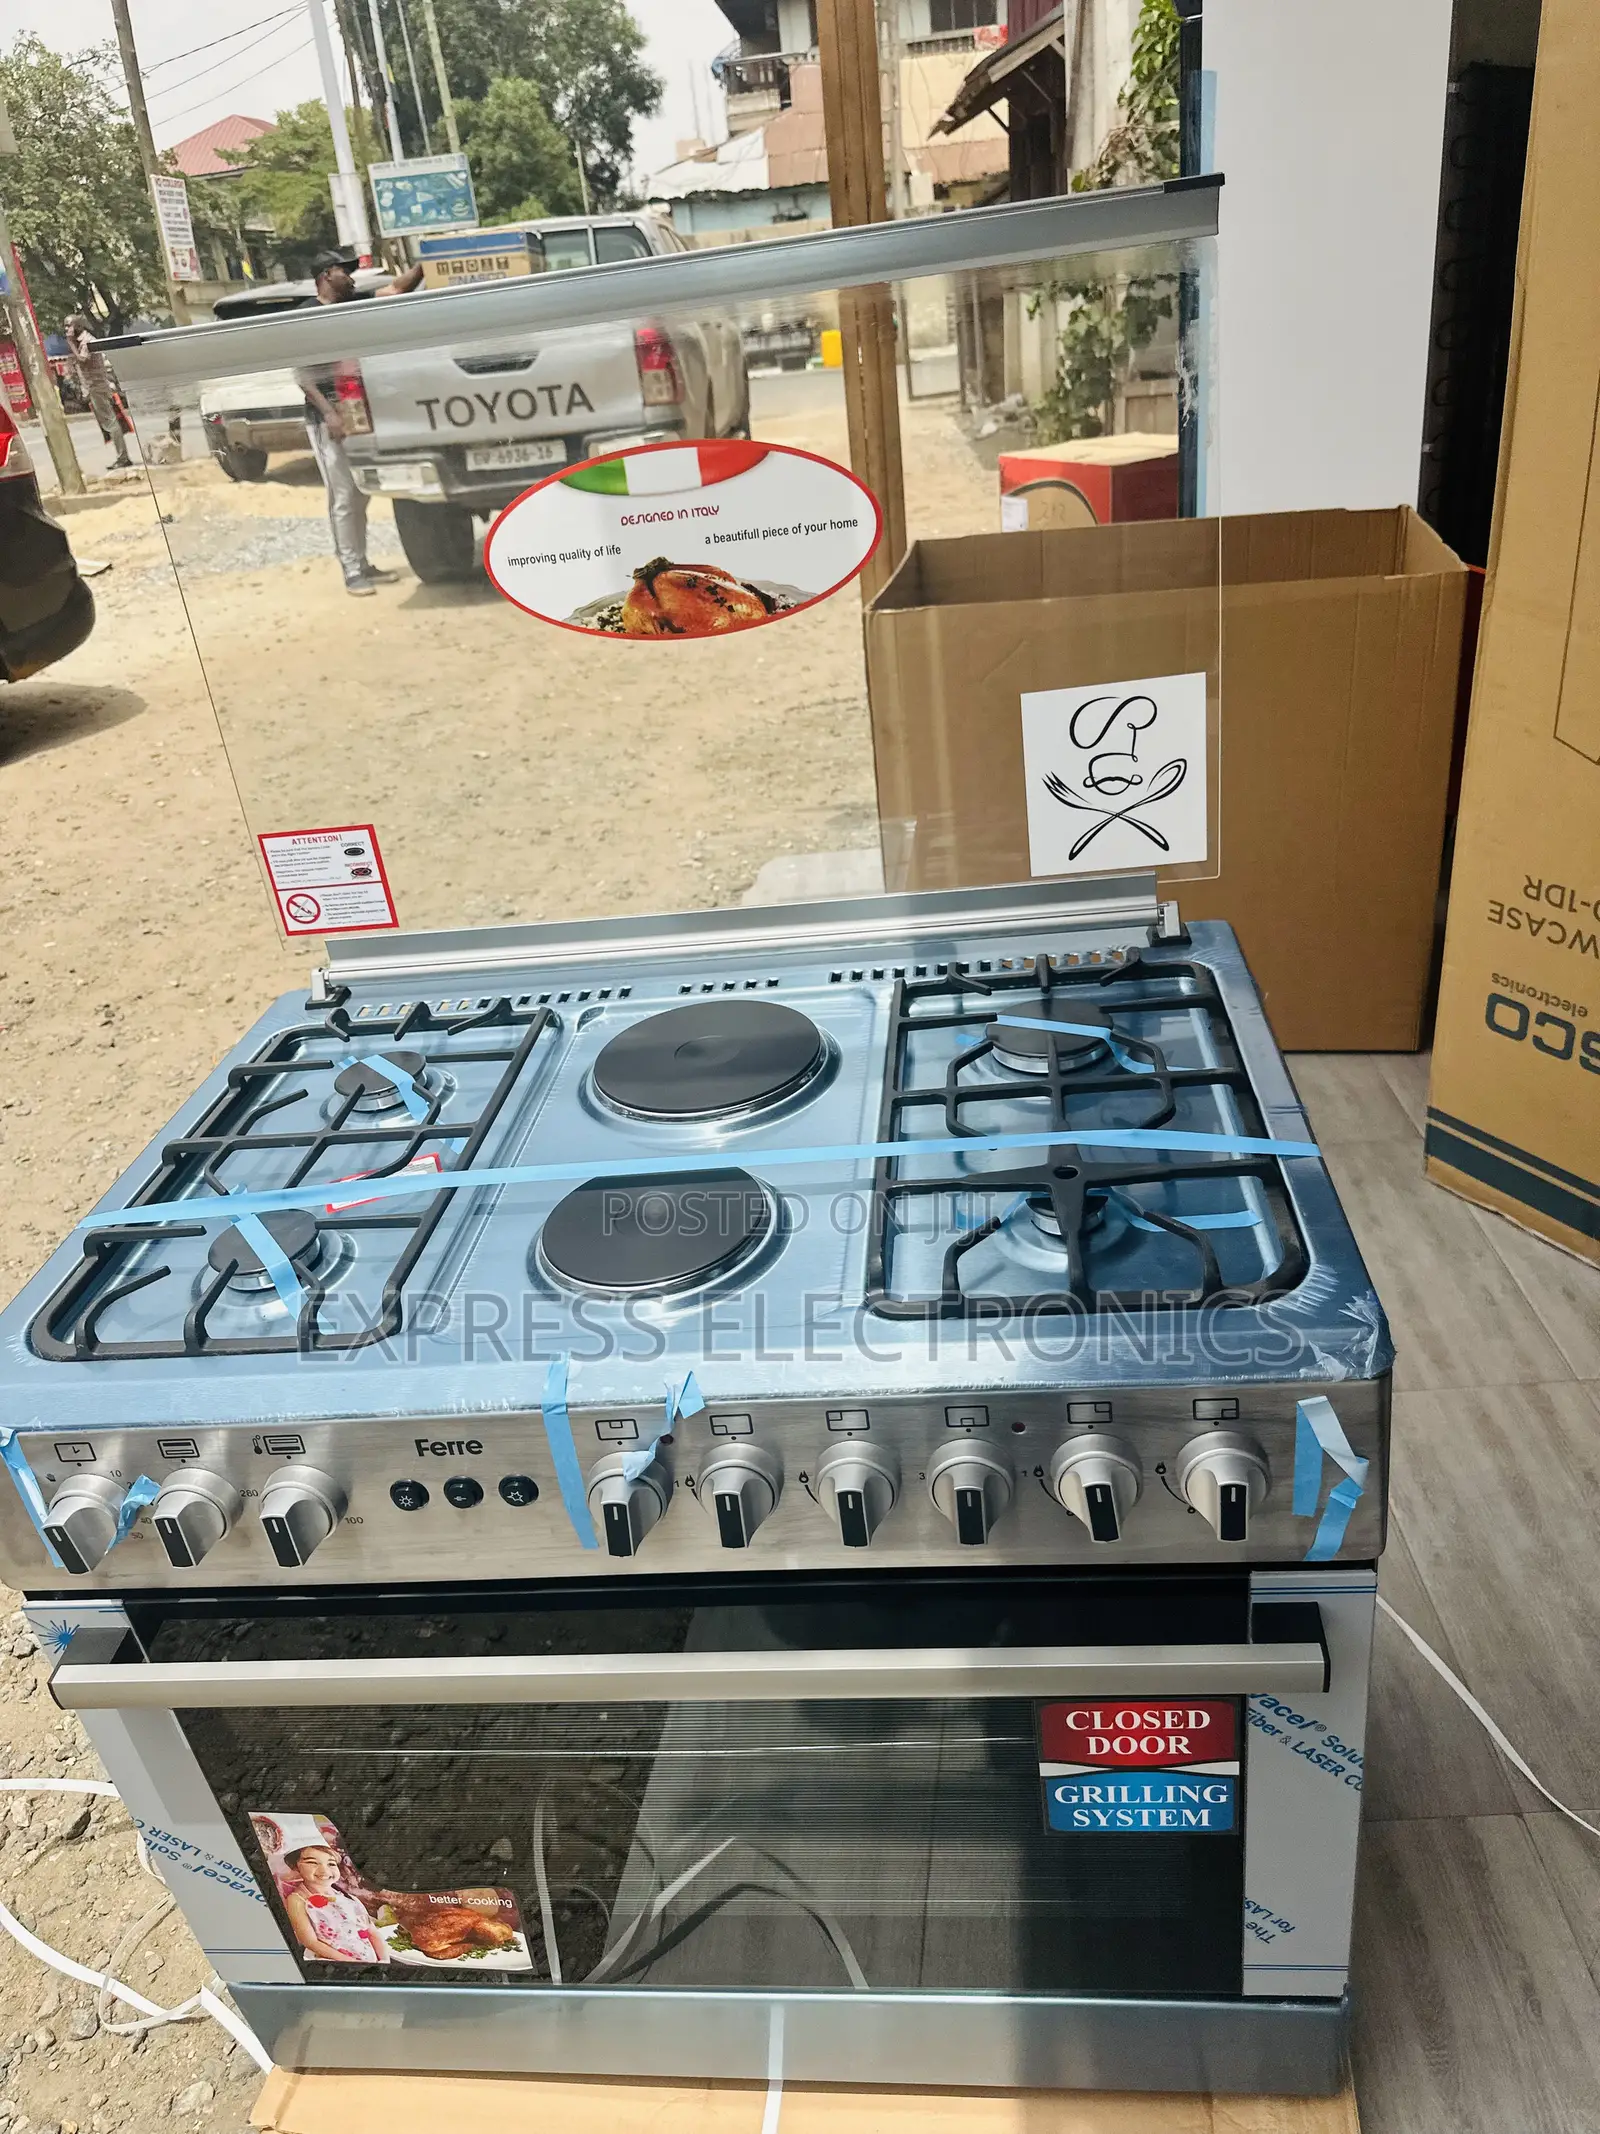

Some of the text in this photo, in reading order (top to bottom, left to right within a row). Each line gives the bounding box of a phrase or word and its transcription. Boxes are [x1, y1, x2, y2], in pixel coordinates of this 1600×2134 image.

[415, 382, 596, 431] TOYOTA
[620, 504, 720, 527] DESIGNED IN ITALY
[704, 517, 859, 545] a beautifull piece of your home
[507, 544, 622, 568] improving quality of life
[291, 833, 343, 846] ATTENTION!
[1491, 972, 1589, 1019] electronics
[414, 1438, 484, 1457] Ferre
[109, 1469, 122, 1478] 10
[918, 1472, 926, 1480] 3
[240, 1489, 259, 1498] 280
[345, 1516, 364, 1525] 100
[1065, 1709, 1211, 1731] CLOSED
[1086, 1735, 1193, 1756] DOOR
[1280, 1735, 1292, 1746] &
[1291, 1741, 1346, 1778] LASER
[1054, 1784, 1230, 1804] GRILLING
[1073, 1808, 1212, 1828] SYSTEM
[149, 1826, 202, 1857] LASER
[204, 1852, 214, 1861] &
[215, 1859, 255, 1884] Fiber
[428, 1894, 513, 1909] better cooking
[1244, 1896, 1296, 1934] for LAS
[1245, 1921, 1276, 1945] The
